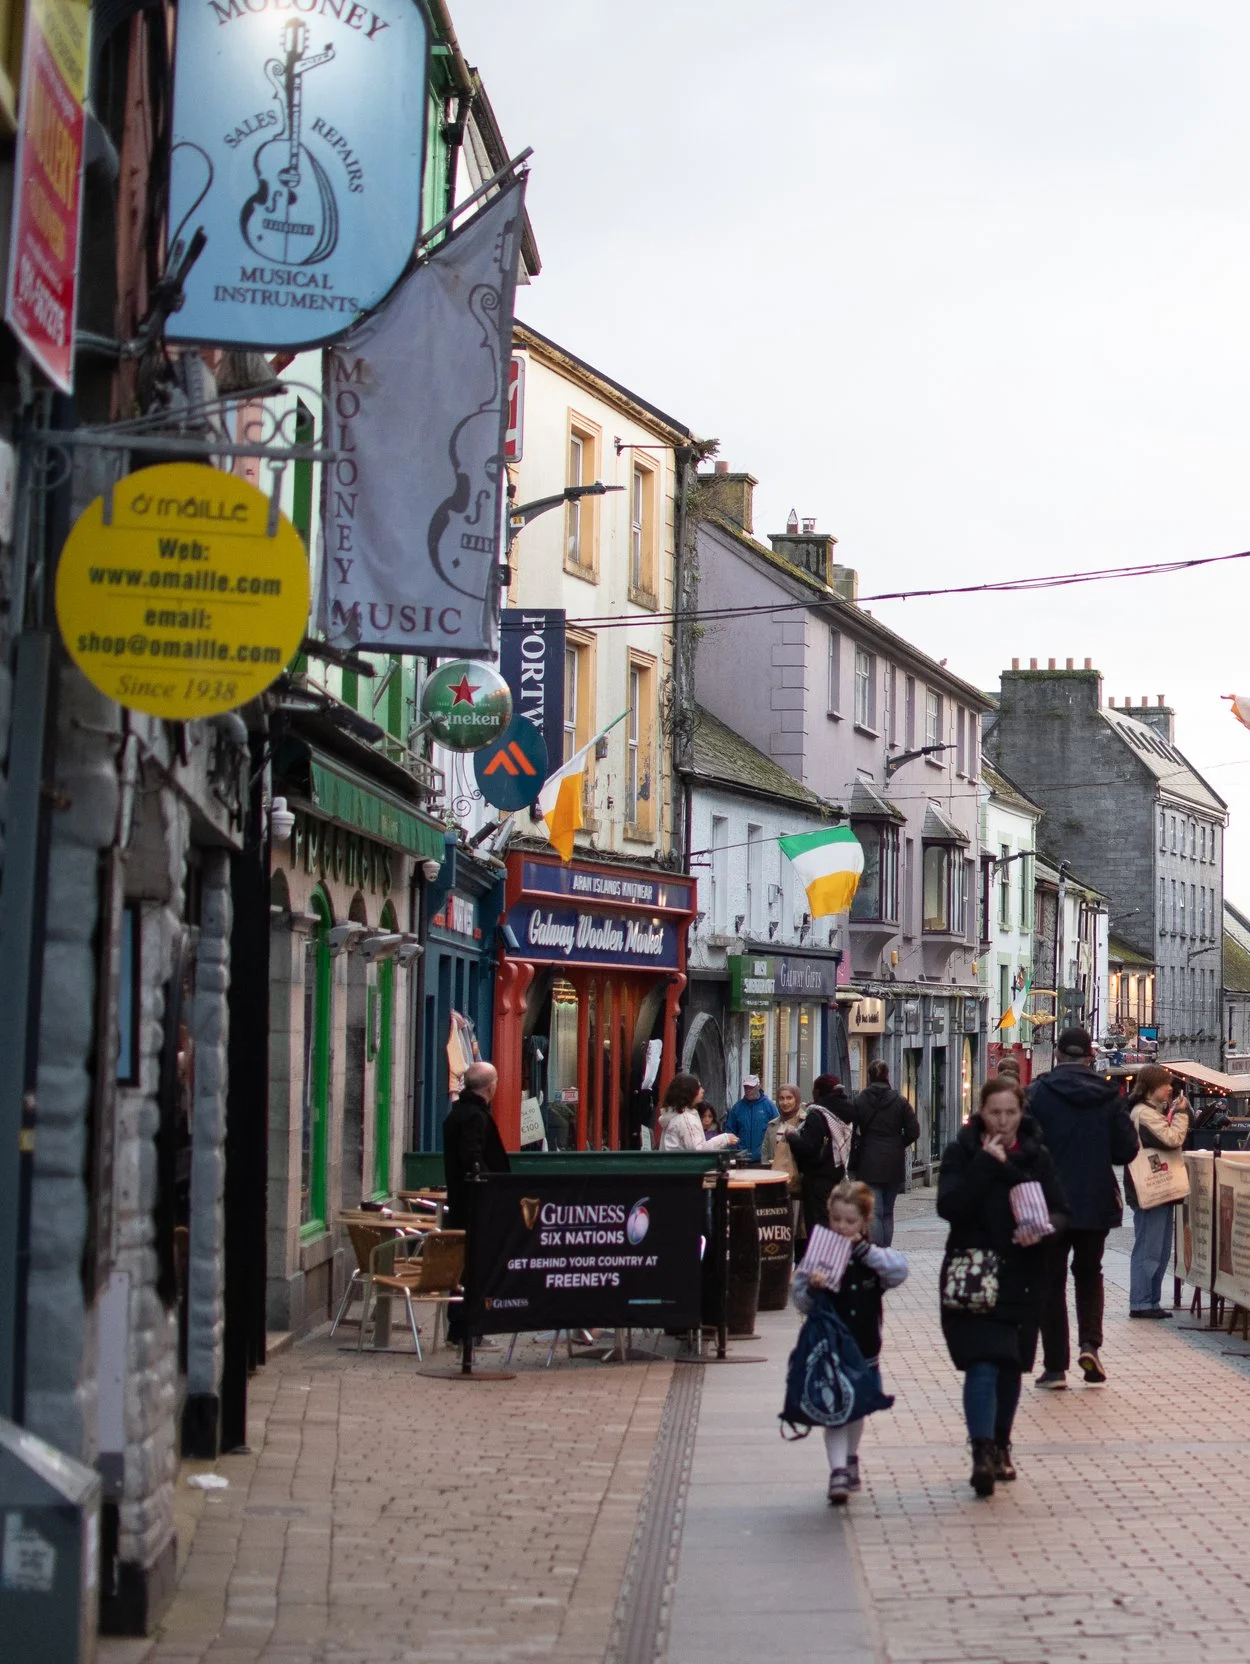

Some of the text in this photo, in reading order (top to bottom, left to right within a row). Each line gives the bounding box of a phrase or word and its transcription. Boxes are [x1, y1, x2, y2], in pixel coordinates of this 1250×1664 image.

[223, 109, 278, 149] SALES
[311, 117, 364, 195] REPAIRS
[239, 266, 334, 290] MUSICAL
[214, 285, 361, 313] INSTRUMENTS
[334, 357, 365, 585] MOLONEY
[157, 537, 210, 562] Web:
[88, 565, 282, 596] www.omaille.com
[144, 607, 212, 631] email:
[331, 598, 462, 635] MUSIC
[77, 631, 282, 664] shop@omaille.com
[116, 673, 176, 699] Since
[429, 710, 501, 726] ineken
[528, 908, 665, 955] Galway Woollen Market
[541, 1203, 625, 1225] GUINNESS
[540, 1230, 625, 1246] SIX NATIONS
[508, 1255, 658, 1270] GET BEHIND YOUR COUNTRY AT
[546, 1273, 620, 1288] FREENEY'S
